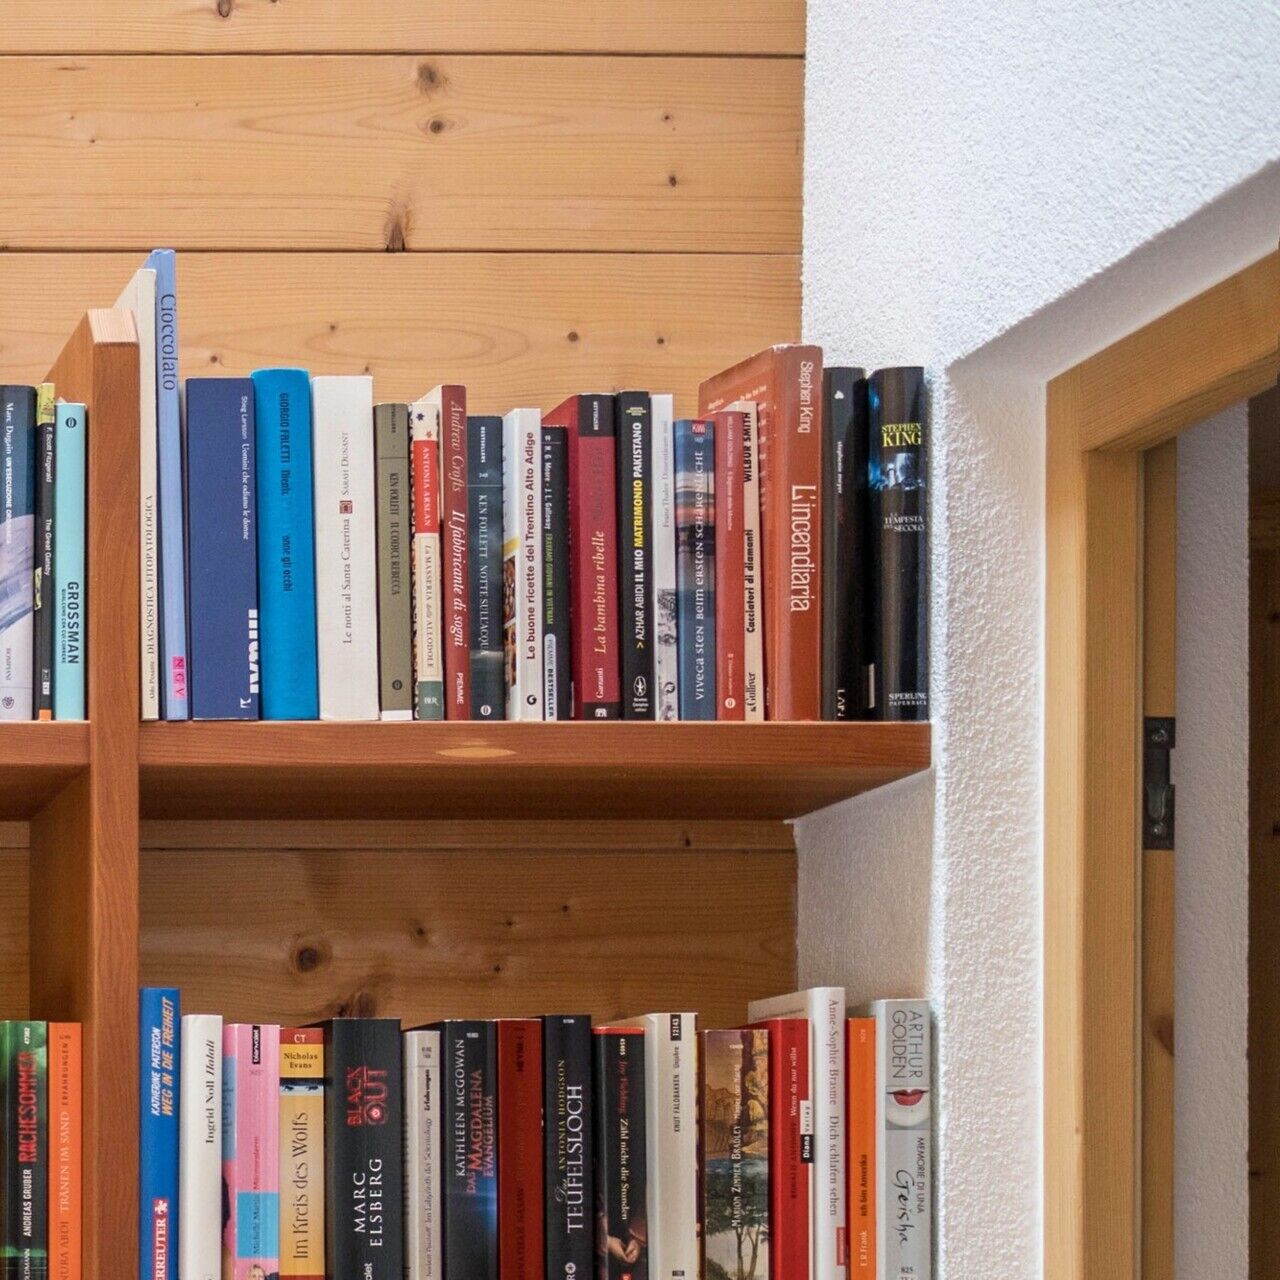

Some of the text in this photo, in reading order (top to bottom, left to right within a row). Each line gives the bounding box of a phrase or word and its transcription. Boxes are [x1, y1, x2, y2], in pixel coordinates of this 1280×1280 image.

[161, 294, 176, 391] Cioccolato
[798, 361, 813, 432] Stephen King
[744, 445, 752, 482] WILBUR
[524, 432, 535, 660] Le buone ricette del Trentino Alto Adige
[633, 422, 644, 640] AZHAR ABIDI IL MIO MATRIMONIO PAKISTANO
[791, 485, 816, 612] L'incendiaria
[68, 581, 79, 664] GROSSMAN
[592, 530, 606, 654] La bambina ribelle
[745, 530, 755, 633] Cacciatori di diamanti
[892, 1010, 907, 1079] GOLDEN
[908, 1011, 923, 1078] ARTHUR
[23, 1169, 32, 1237] ANDREAS GRUBER
[292, 1113, 308, 1259] Im Kreis des Wolfs
[354, 1173, 366, 1233] MARC
[369, 1159, 382, 1247] ELSBERG
[567, 1086, 583, 1233] TEUFELSLOCH
